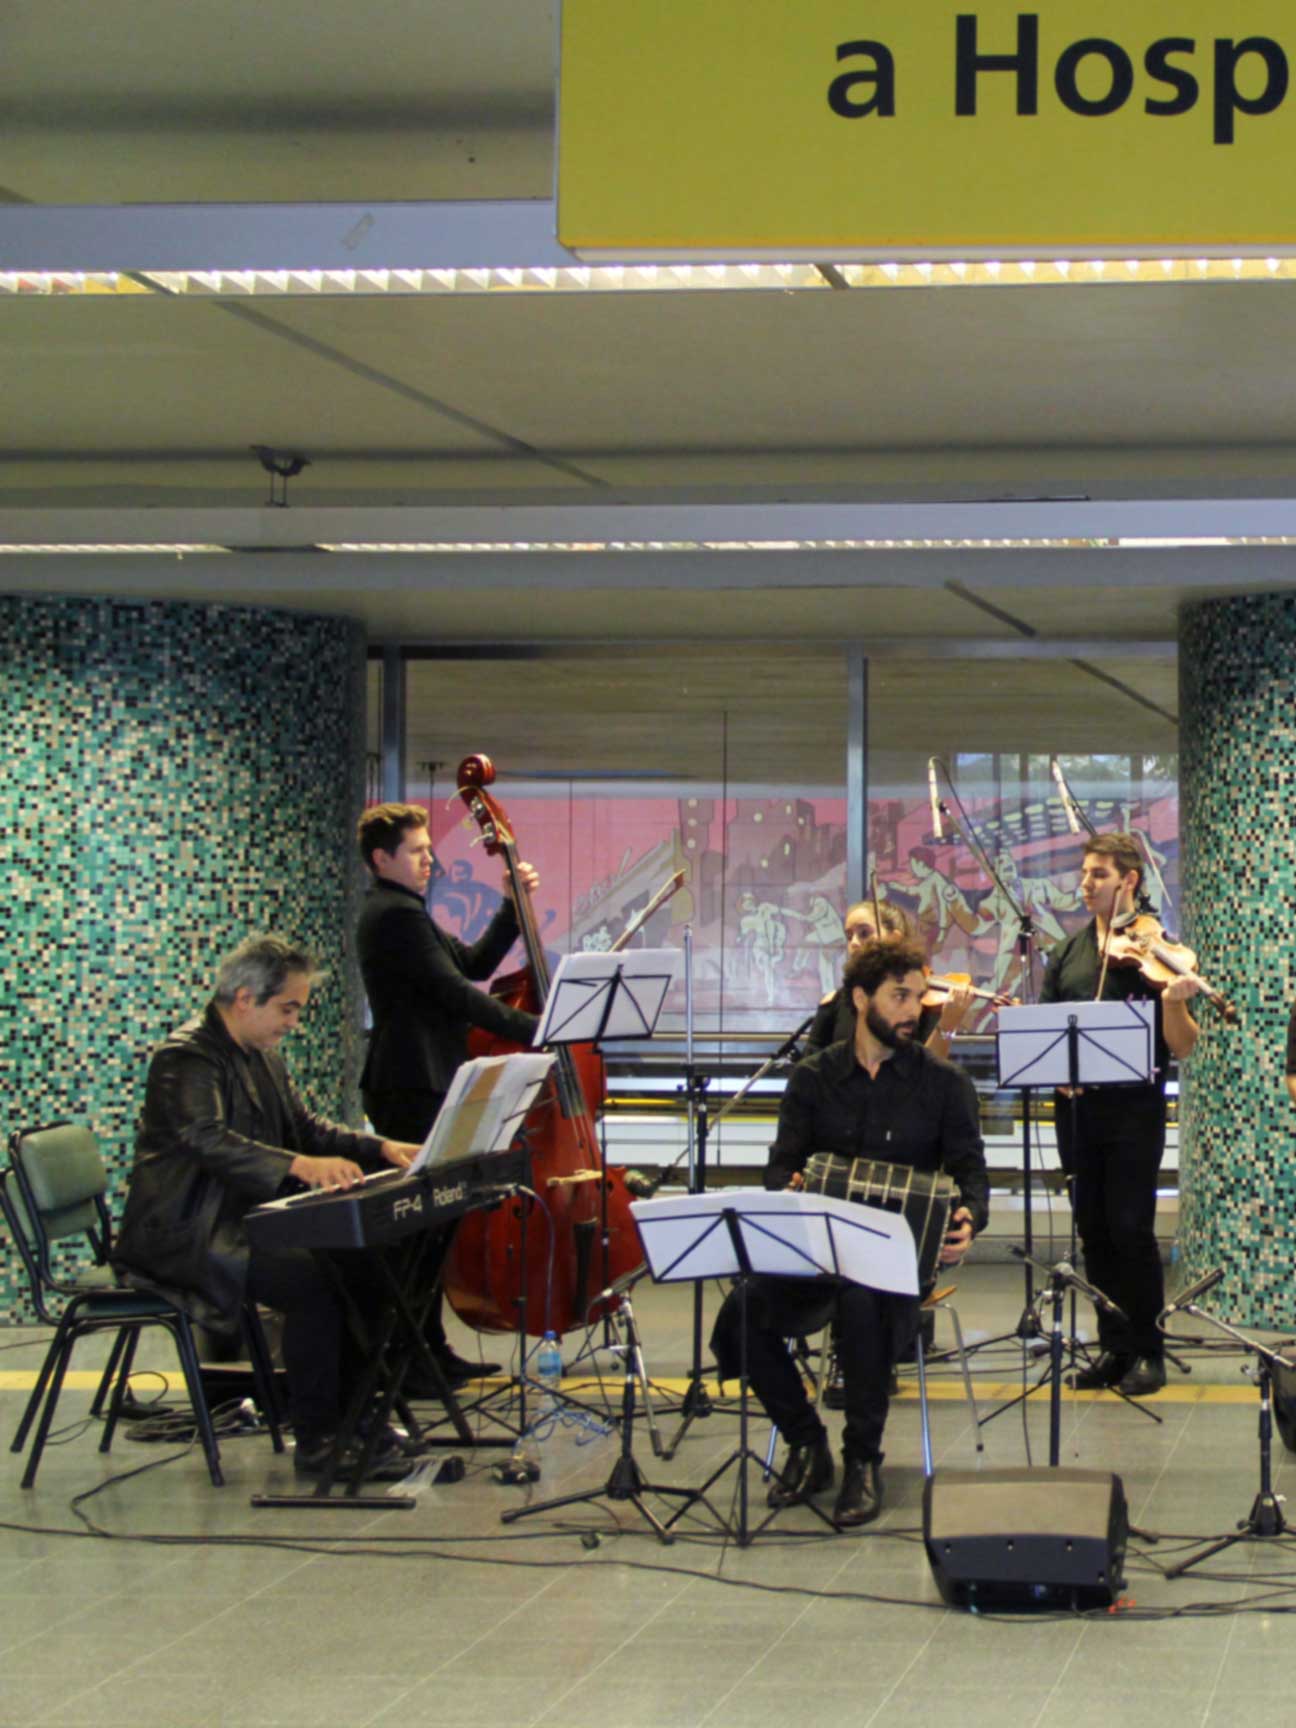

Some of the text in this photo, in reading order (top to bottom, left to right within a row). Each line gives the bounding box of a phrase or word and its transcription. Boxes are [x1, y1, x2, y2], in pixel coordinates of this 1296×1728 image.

[827, 40, 895, 119] a
[392, 1182, 465, 1222] FP-4 Roland
